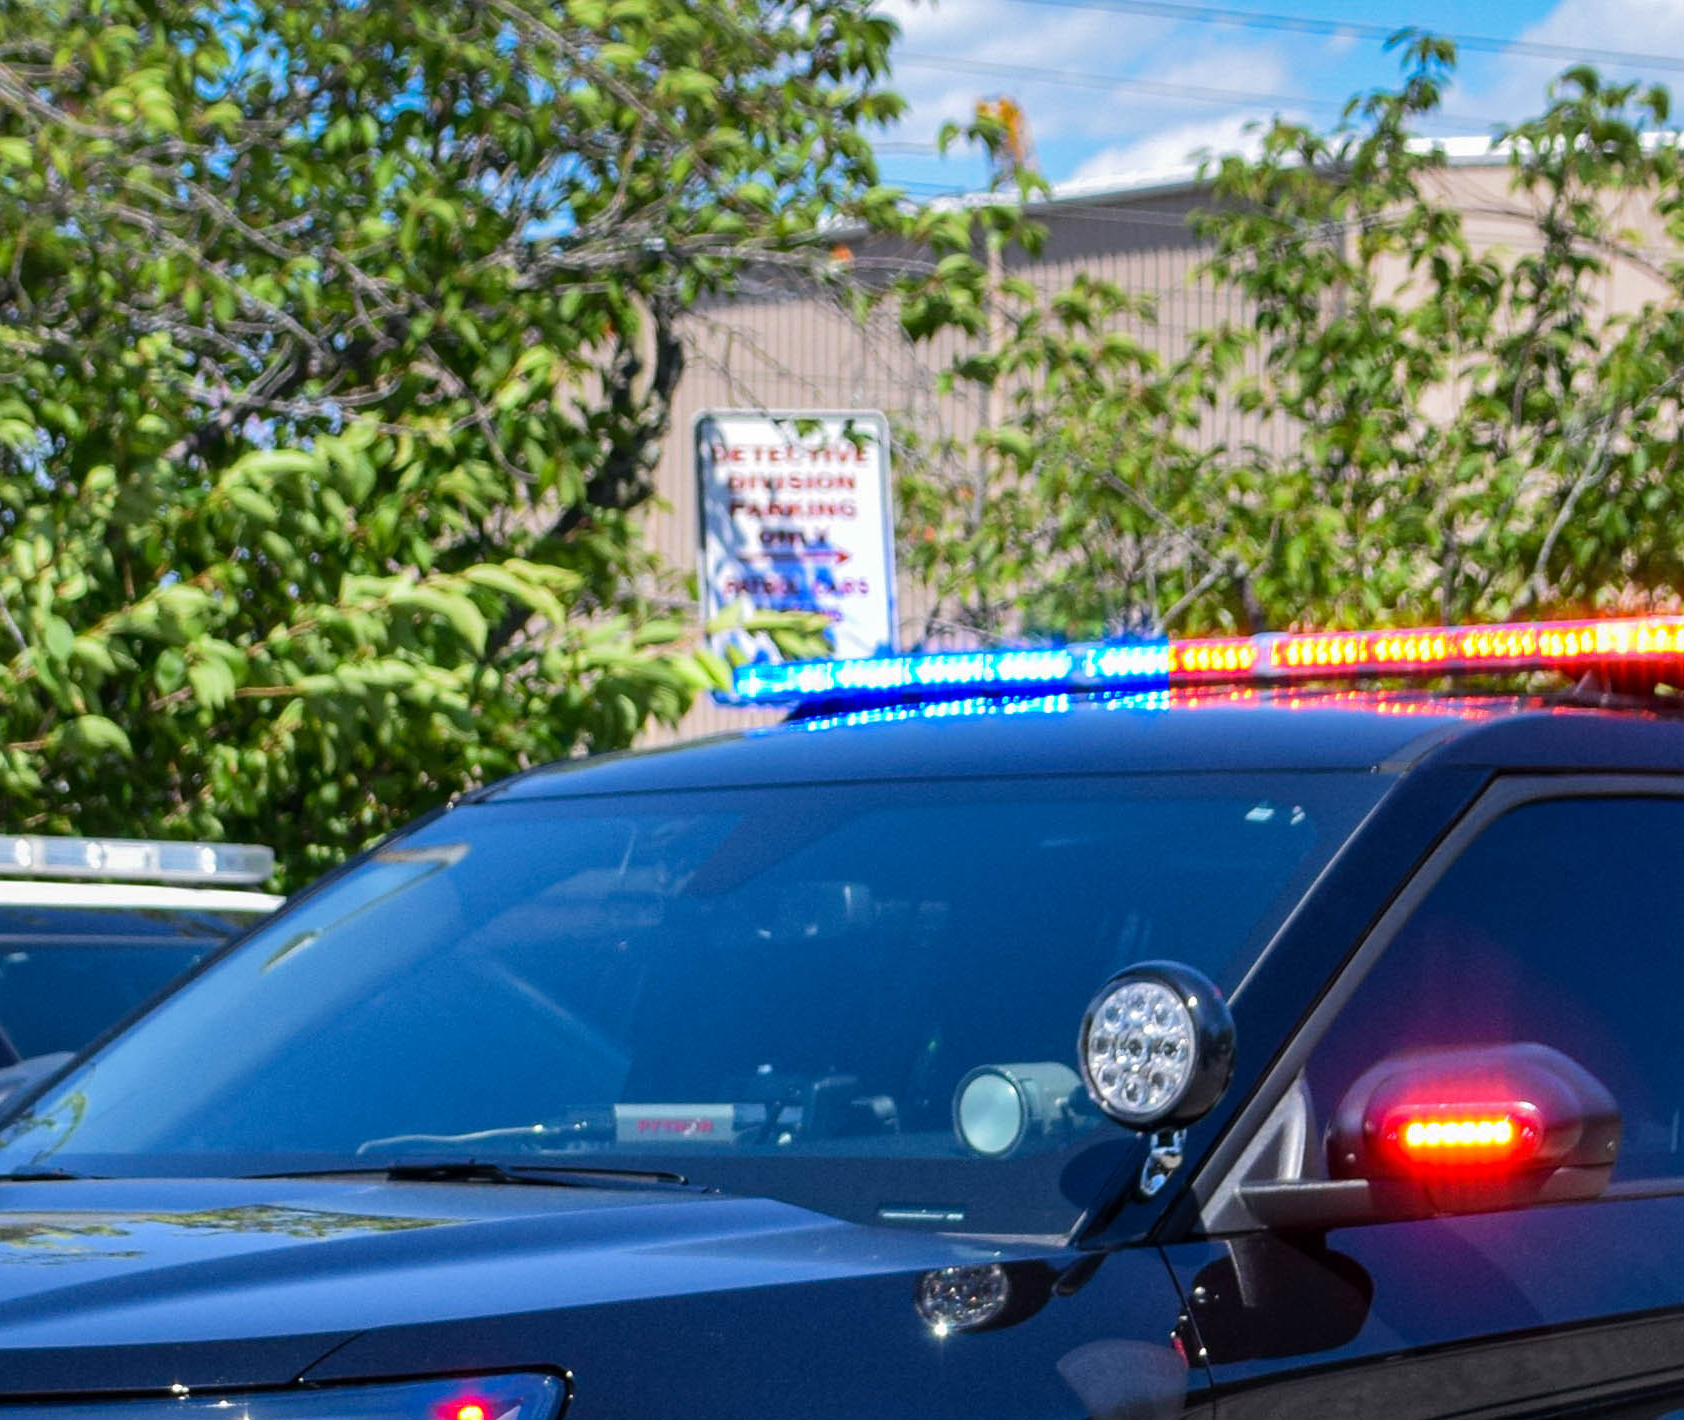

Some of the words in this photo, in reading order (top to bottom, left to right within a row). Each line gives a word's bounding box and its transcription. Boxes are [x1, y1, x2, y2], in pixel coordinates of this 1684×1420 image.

[711, 447, 869, 463] DETECTIVE
[728, 475, 857, 490] DIVISION
[728, 503, 857, 518] PARKING
